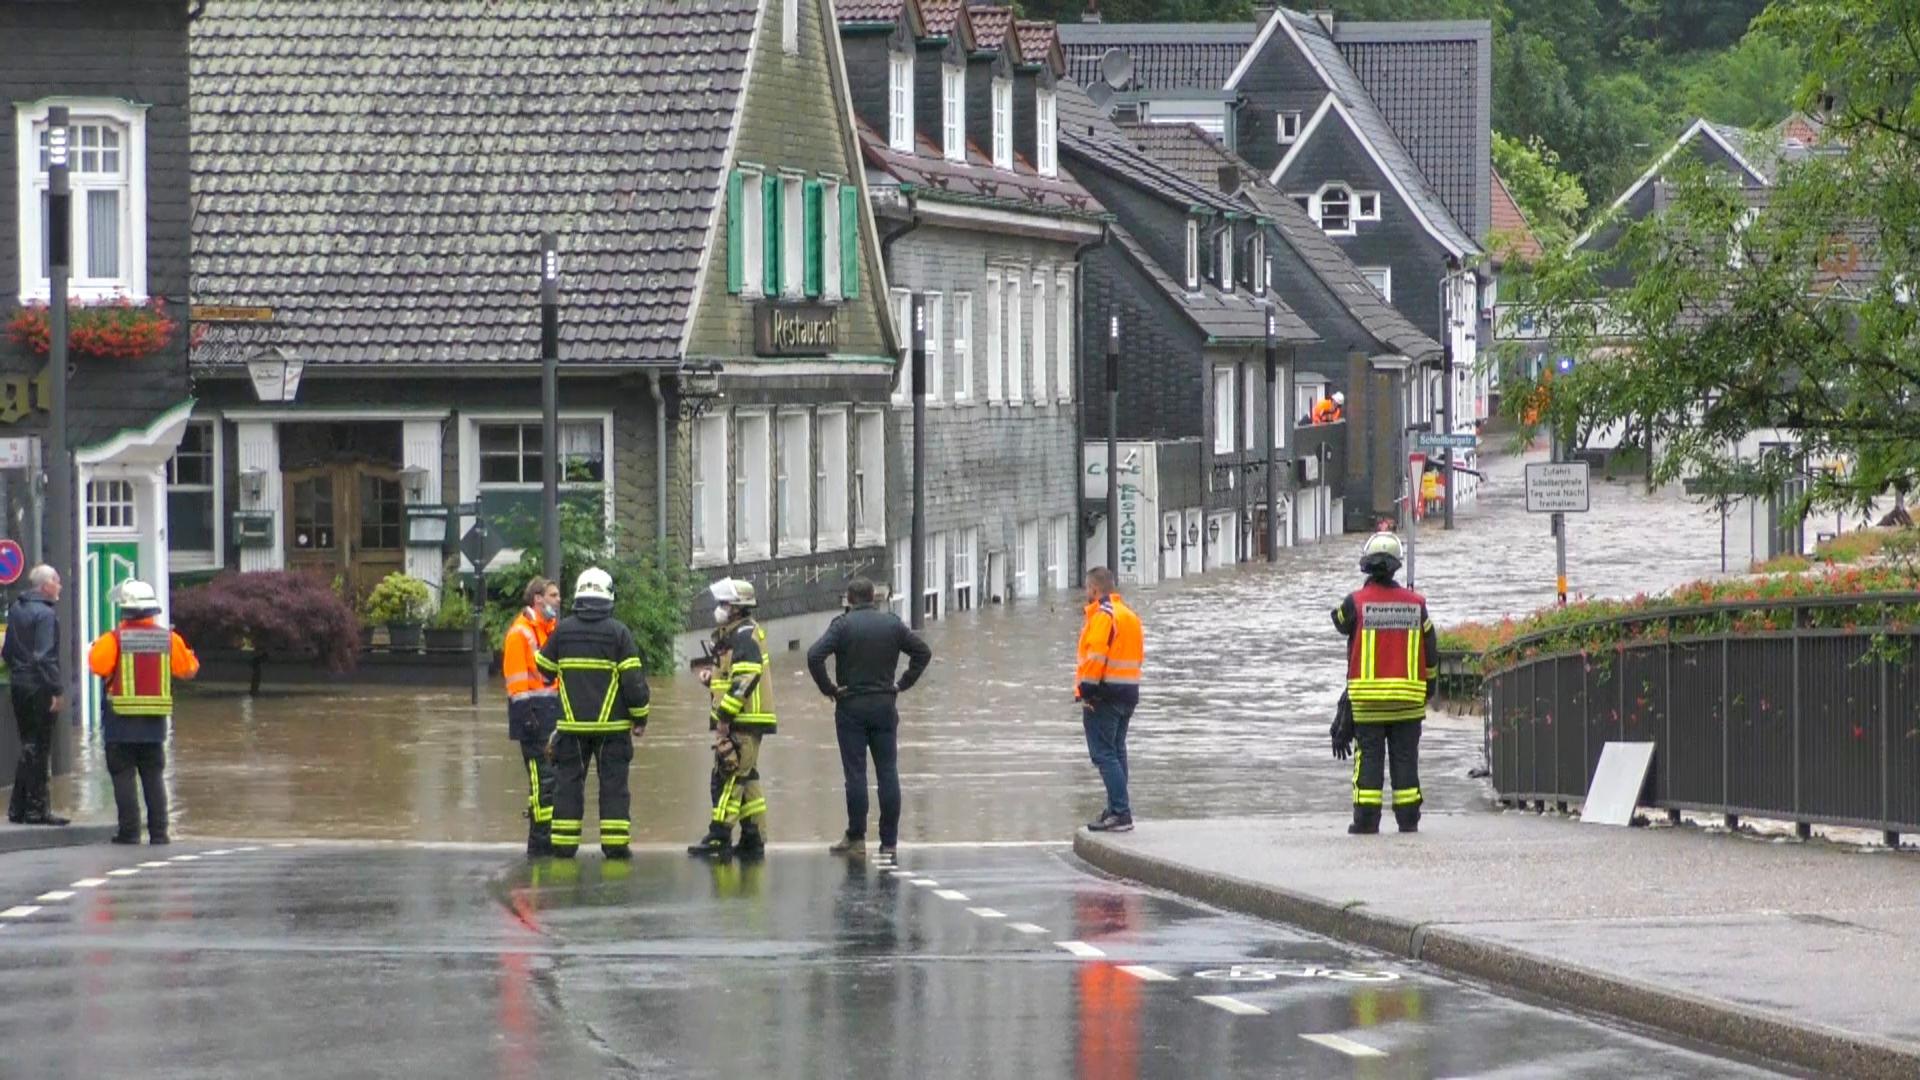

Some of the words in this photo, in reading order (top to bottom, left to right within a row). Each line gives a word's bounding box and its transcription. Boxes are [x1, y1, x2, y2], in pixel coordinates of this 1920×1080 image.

[774, 309, 837, 348] Restaurant
[1543, 467, 1571, 477] Zufahrt
[1530, 489, 1543, 498] Tag
[1546, 489, 1560, 497] und
[1563, 489, 1585, 497] Nacht
[1539, 499, 1577, 507] freihalten
[1120, 483, 1137, 572] RESTAURANT
[1365, 606, 1417, 614] Feuerwehr
